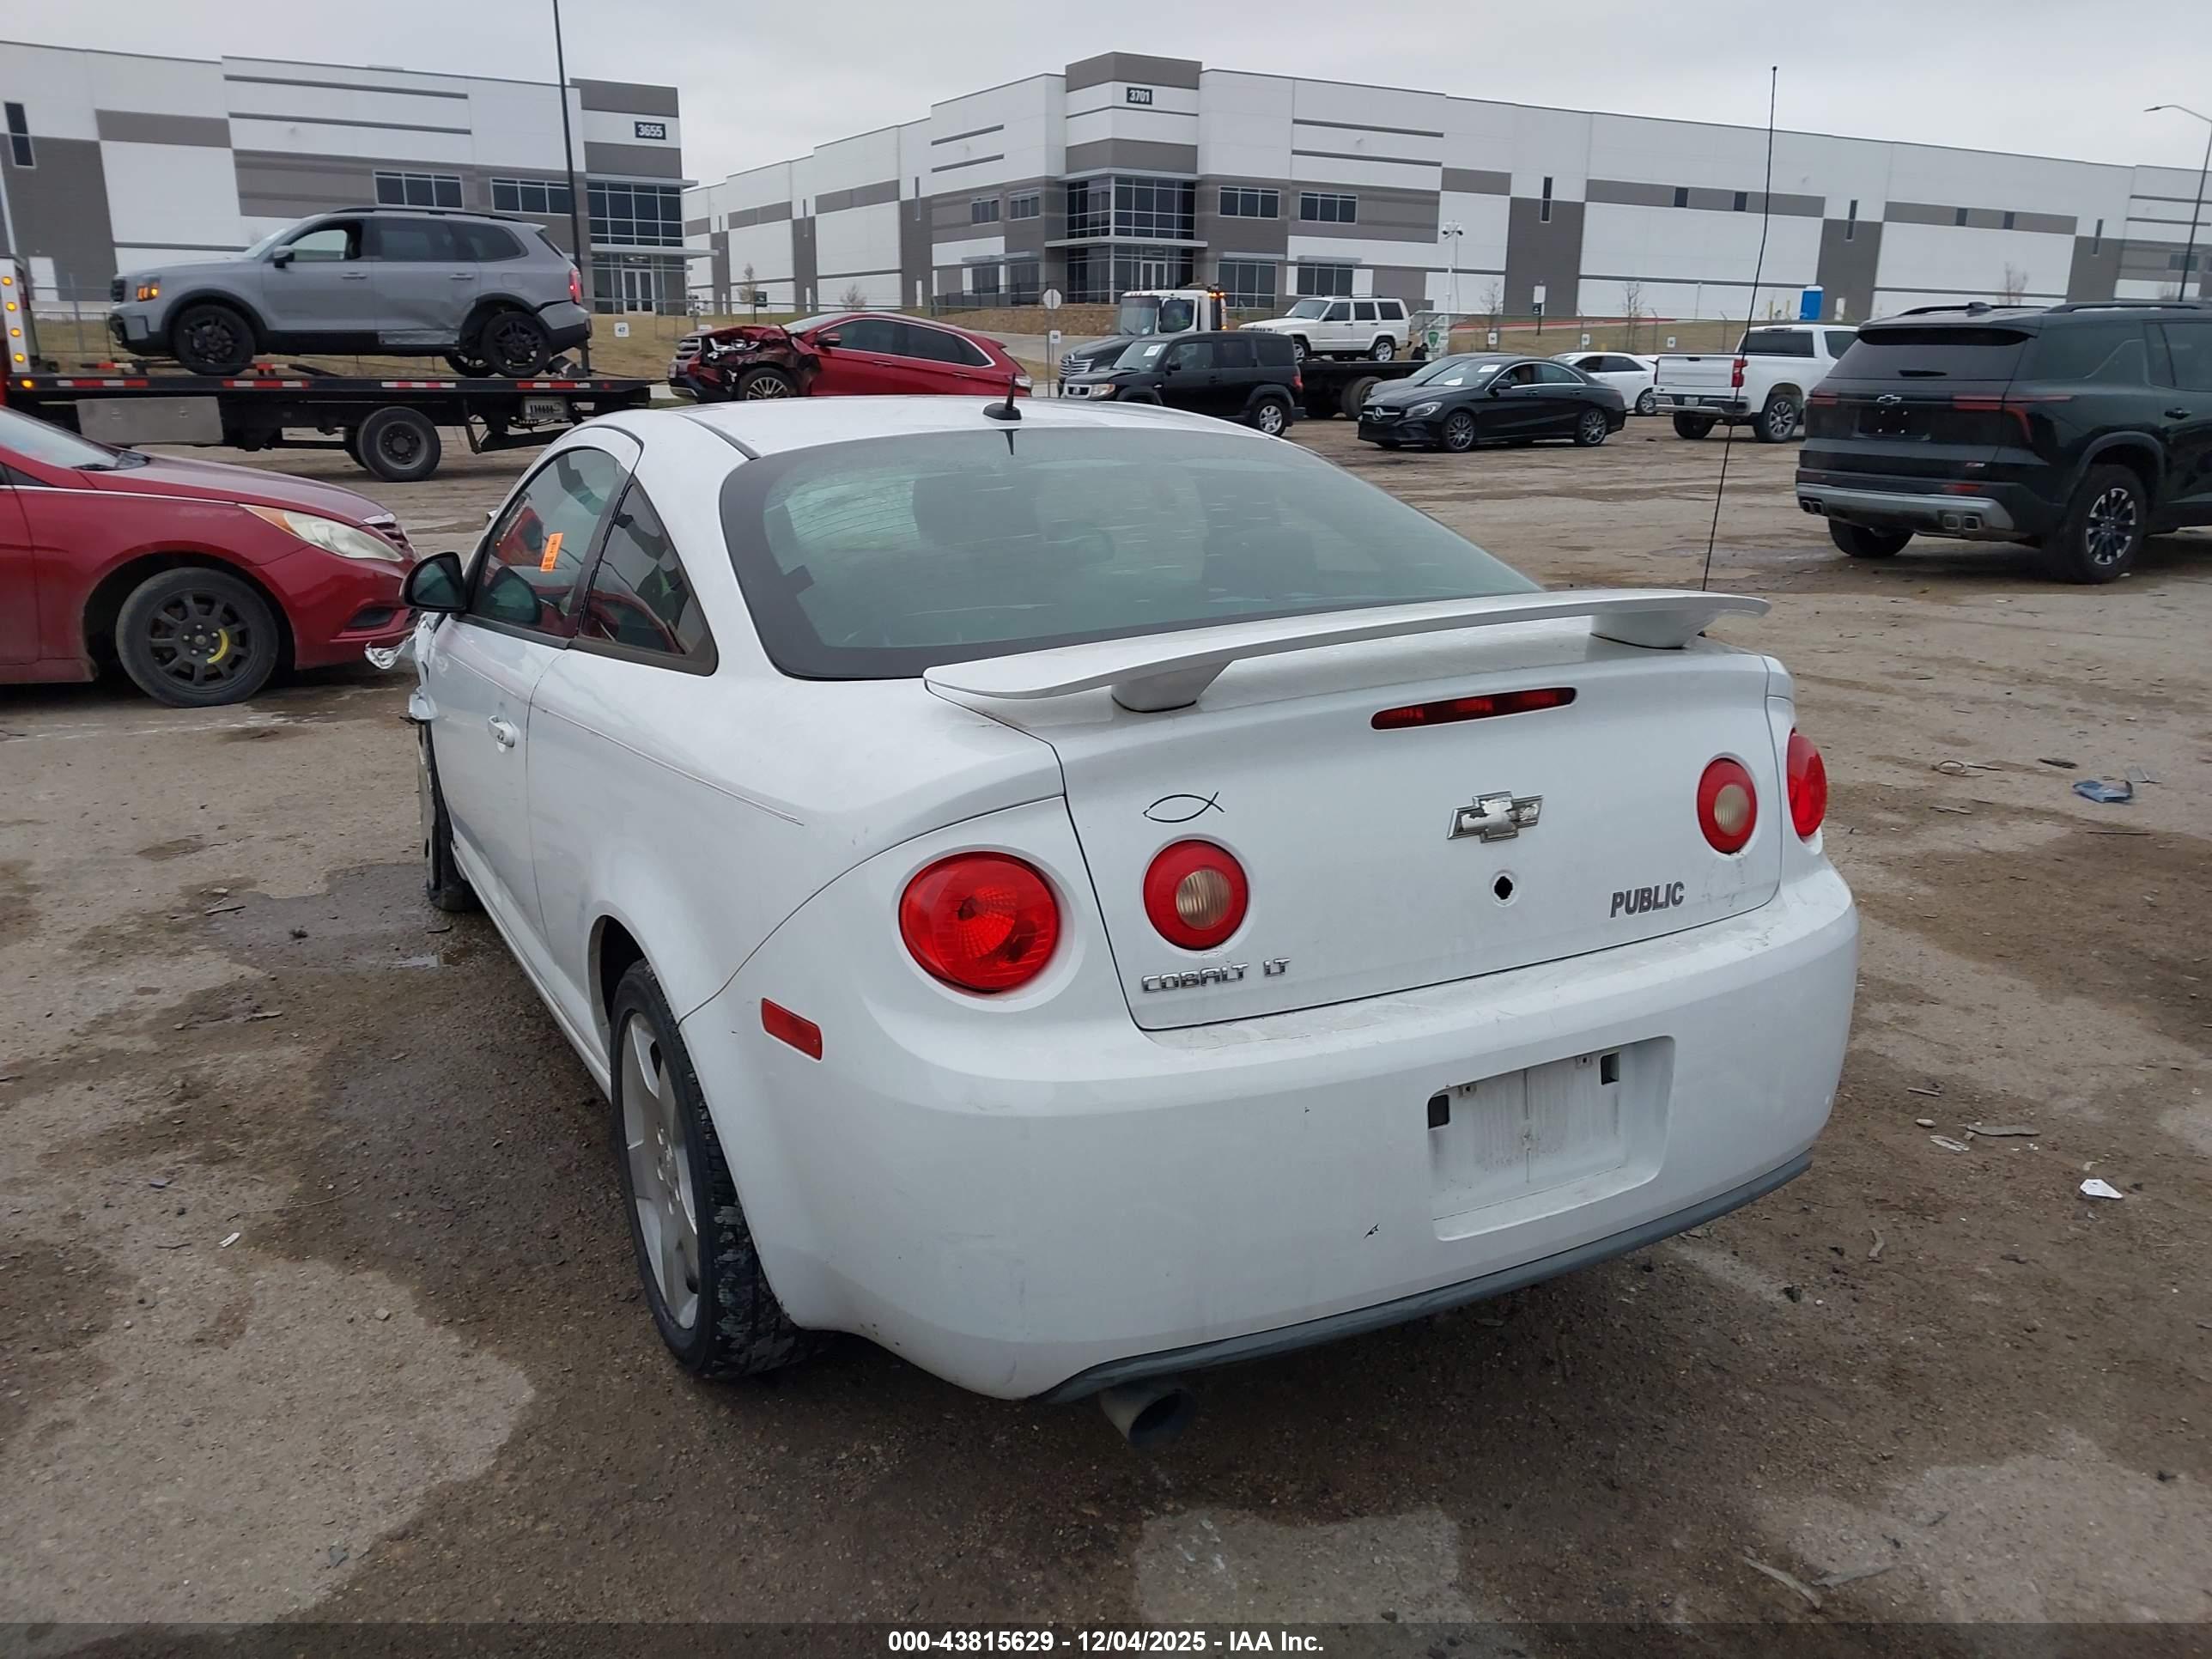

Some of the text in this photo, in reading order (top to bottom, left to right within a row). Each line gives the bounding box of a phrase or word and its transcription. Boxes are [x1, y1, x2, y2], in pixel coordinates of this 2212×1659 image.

[1129, 89, 1150, 102] 3701
[637, 124, 664, 137] 3655
[1609, 880, 1686, 919] PUBLIC
[1141, 957, 1291, 994] COBALT LT
